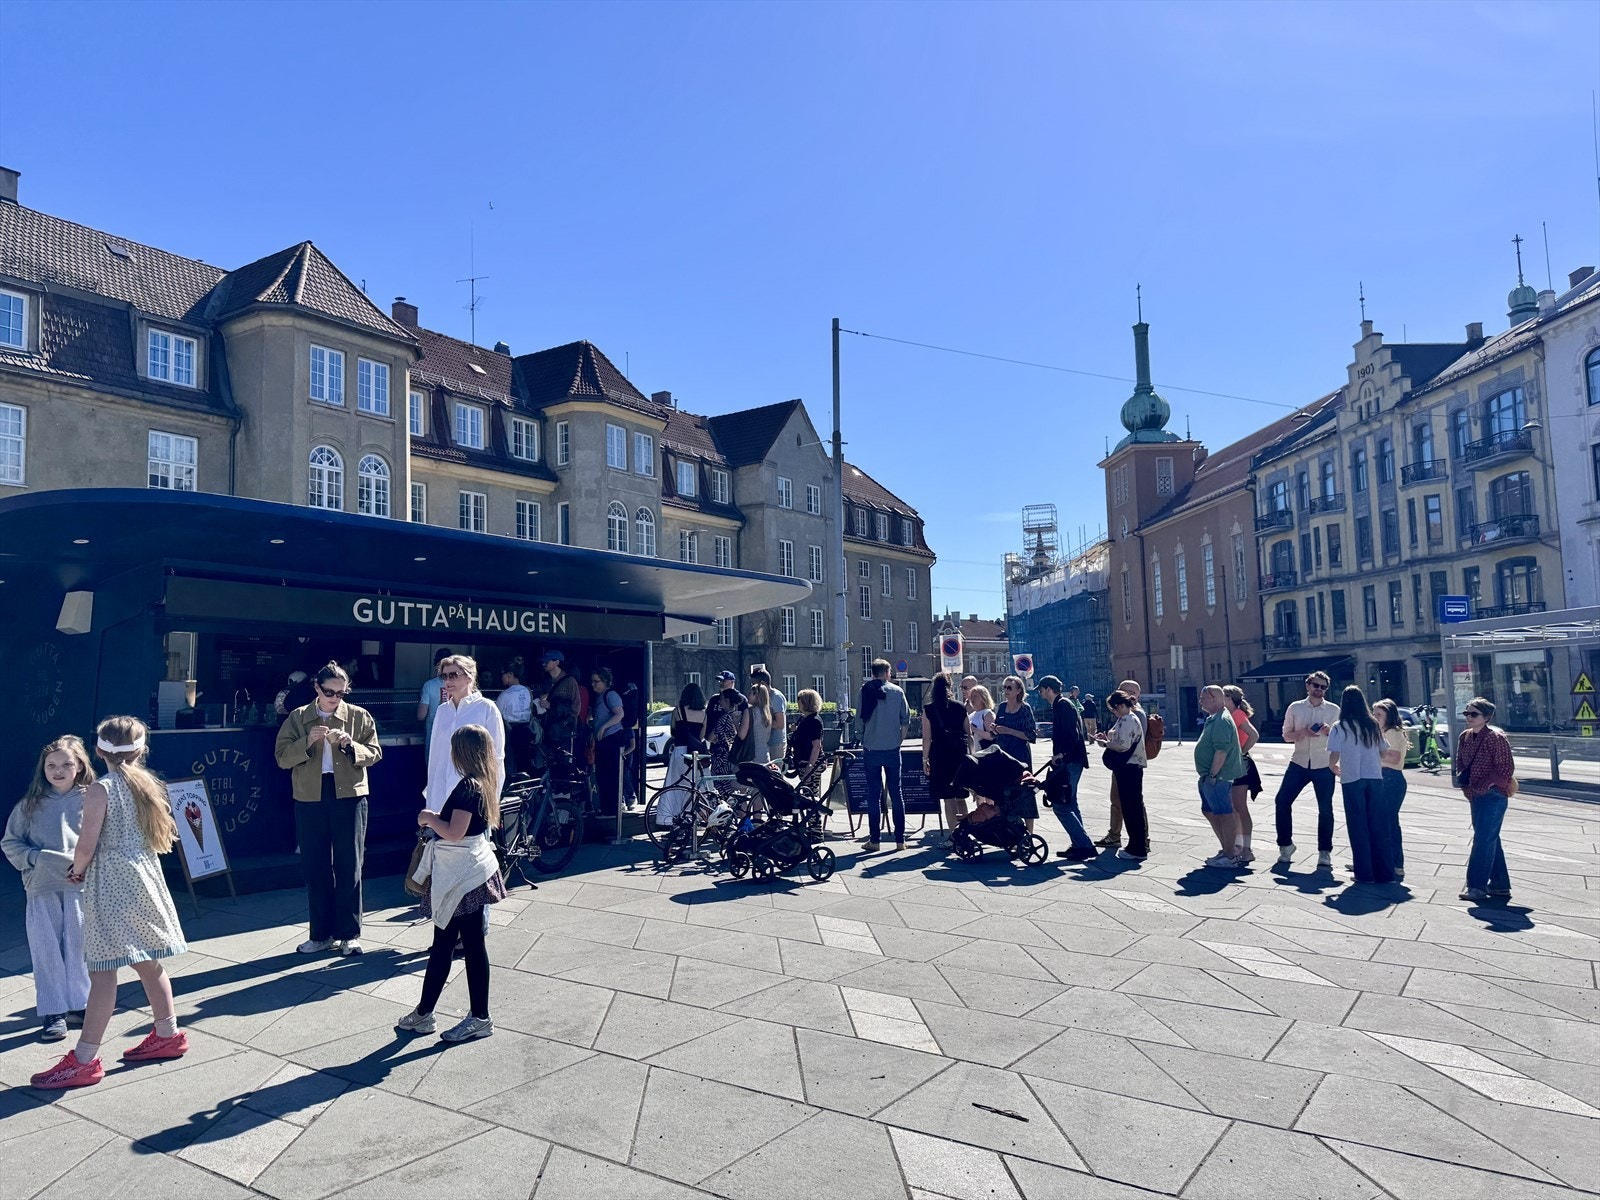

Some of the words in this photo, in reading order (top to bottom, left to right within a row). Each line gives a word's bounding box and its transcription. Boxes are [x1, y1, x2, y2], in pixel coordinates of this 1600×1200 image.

[353, 598, 449, 627] GUTTA
[449, 603, 465, 619] PÅ
[467, 607, 566, 634] HAUGEN
[191, 749, 251, 774] GUTTA
[211, 777, 234, 790] ETBL
[186, 792, 207, 807] TOPPING
[213, 793, 235, 806] 994
[224, 787, 261, 832] UGEN
